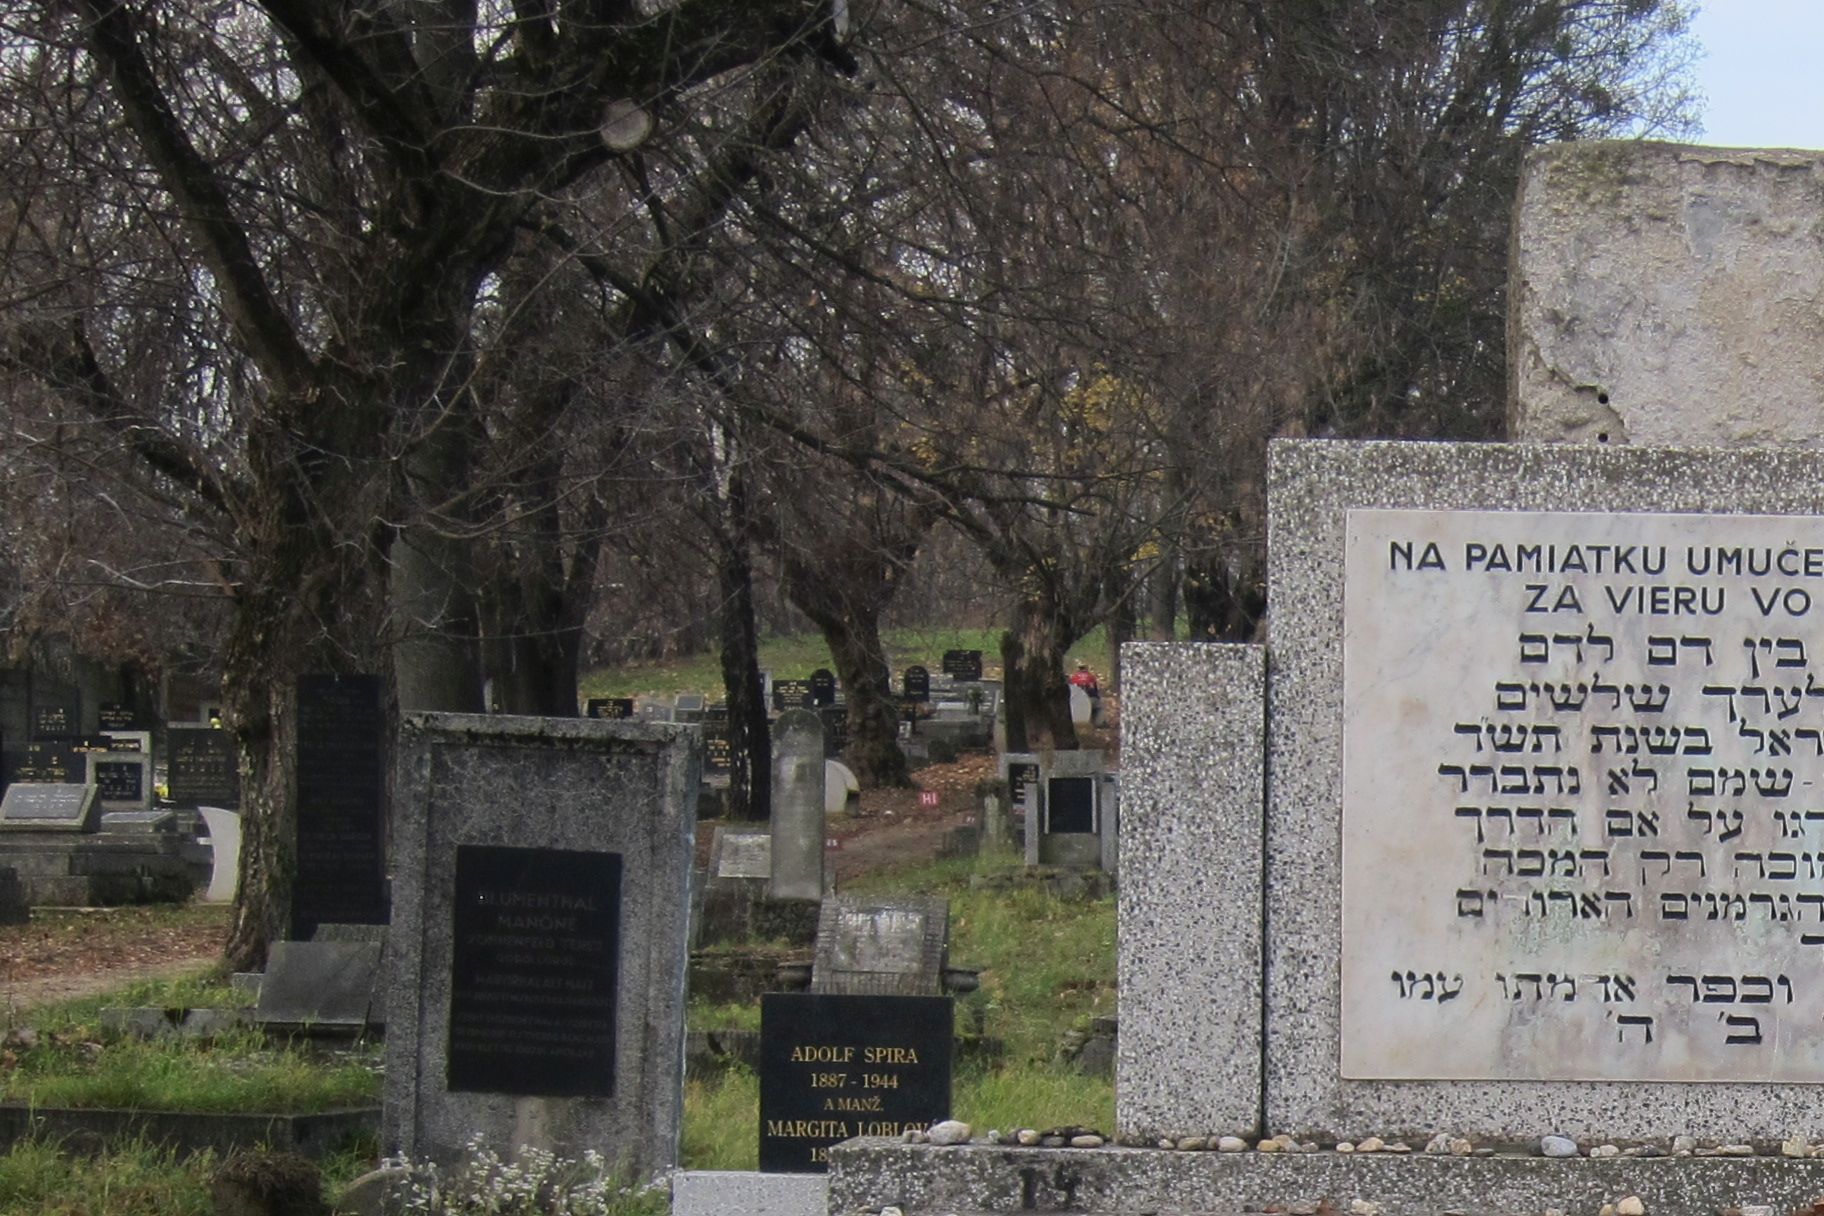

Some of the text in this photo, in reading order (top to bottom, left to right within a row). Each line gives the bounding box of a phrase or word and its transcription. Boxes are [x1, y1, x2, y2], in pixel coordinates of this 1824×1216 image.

[1389, 542, 1446, 571] NA
[1466, 544, 1667, 575] PAMIATKU
[1525, 585, 1583, 614] ZA
[1606, 586, 1725, 615] VIERU
[1751, 588, 1811, 616] VO
[1519, 624, 1614, 663] לדם
[1647, 636, 1713, 666] דם
[1744, 638, 1807, 679] בין
[1496, 672, 1670, 712] שלשים
[1591, 726, 1713, 754] בשנת
[1438, 764, 1580, 794] נתברר
[1607, 759, 1658, 793] לא
[1687, 768, 1793, 797] שמם
[1454, 806, 1577, 842] הדרך
[1606, 809, 1659, 837] אם
[1687, 802, 1744, 842] על
[1484, 848, 1610, 877] המכה
[1640, 850, 1706, 885] רק
[1392, 970, 1463, 1003] עמו
[1667, 974, 1793, 1003] וכפר
[791, 1047, 918, 1063] ADOLF SPIRA
[811, 1073, 847, 1088] 1887
[863, 1074, 898, 1088] 1944
[824, 1096, 884, 1111] A MANŽ.
[768, 1120, 848, 1137] MARGITA
